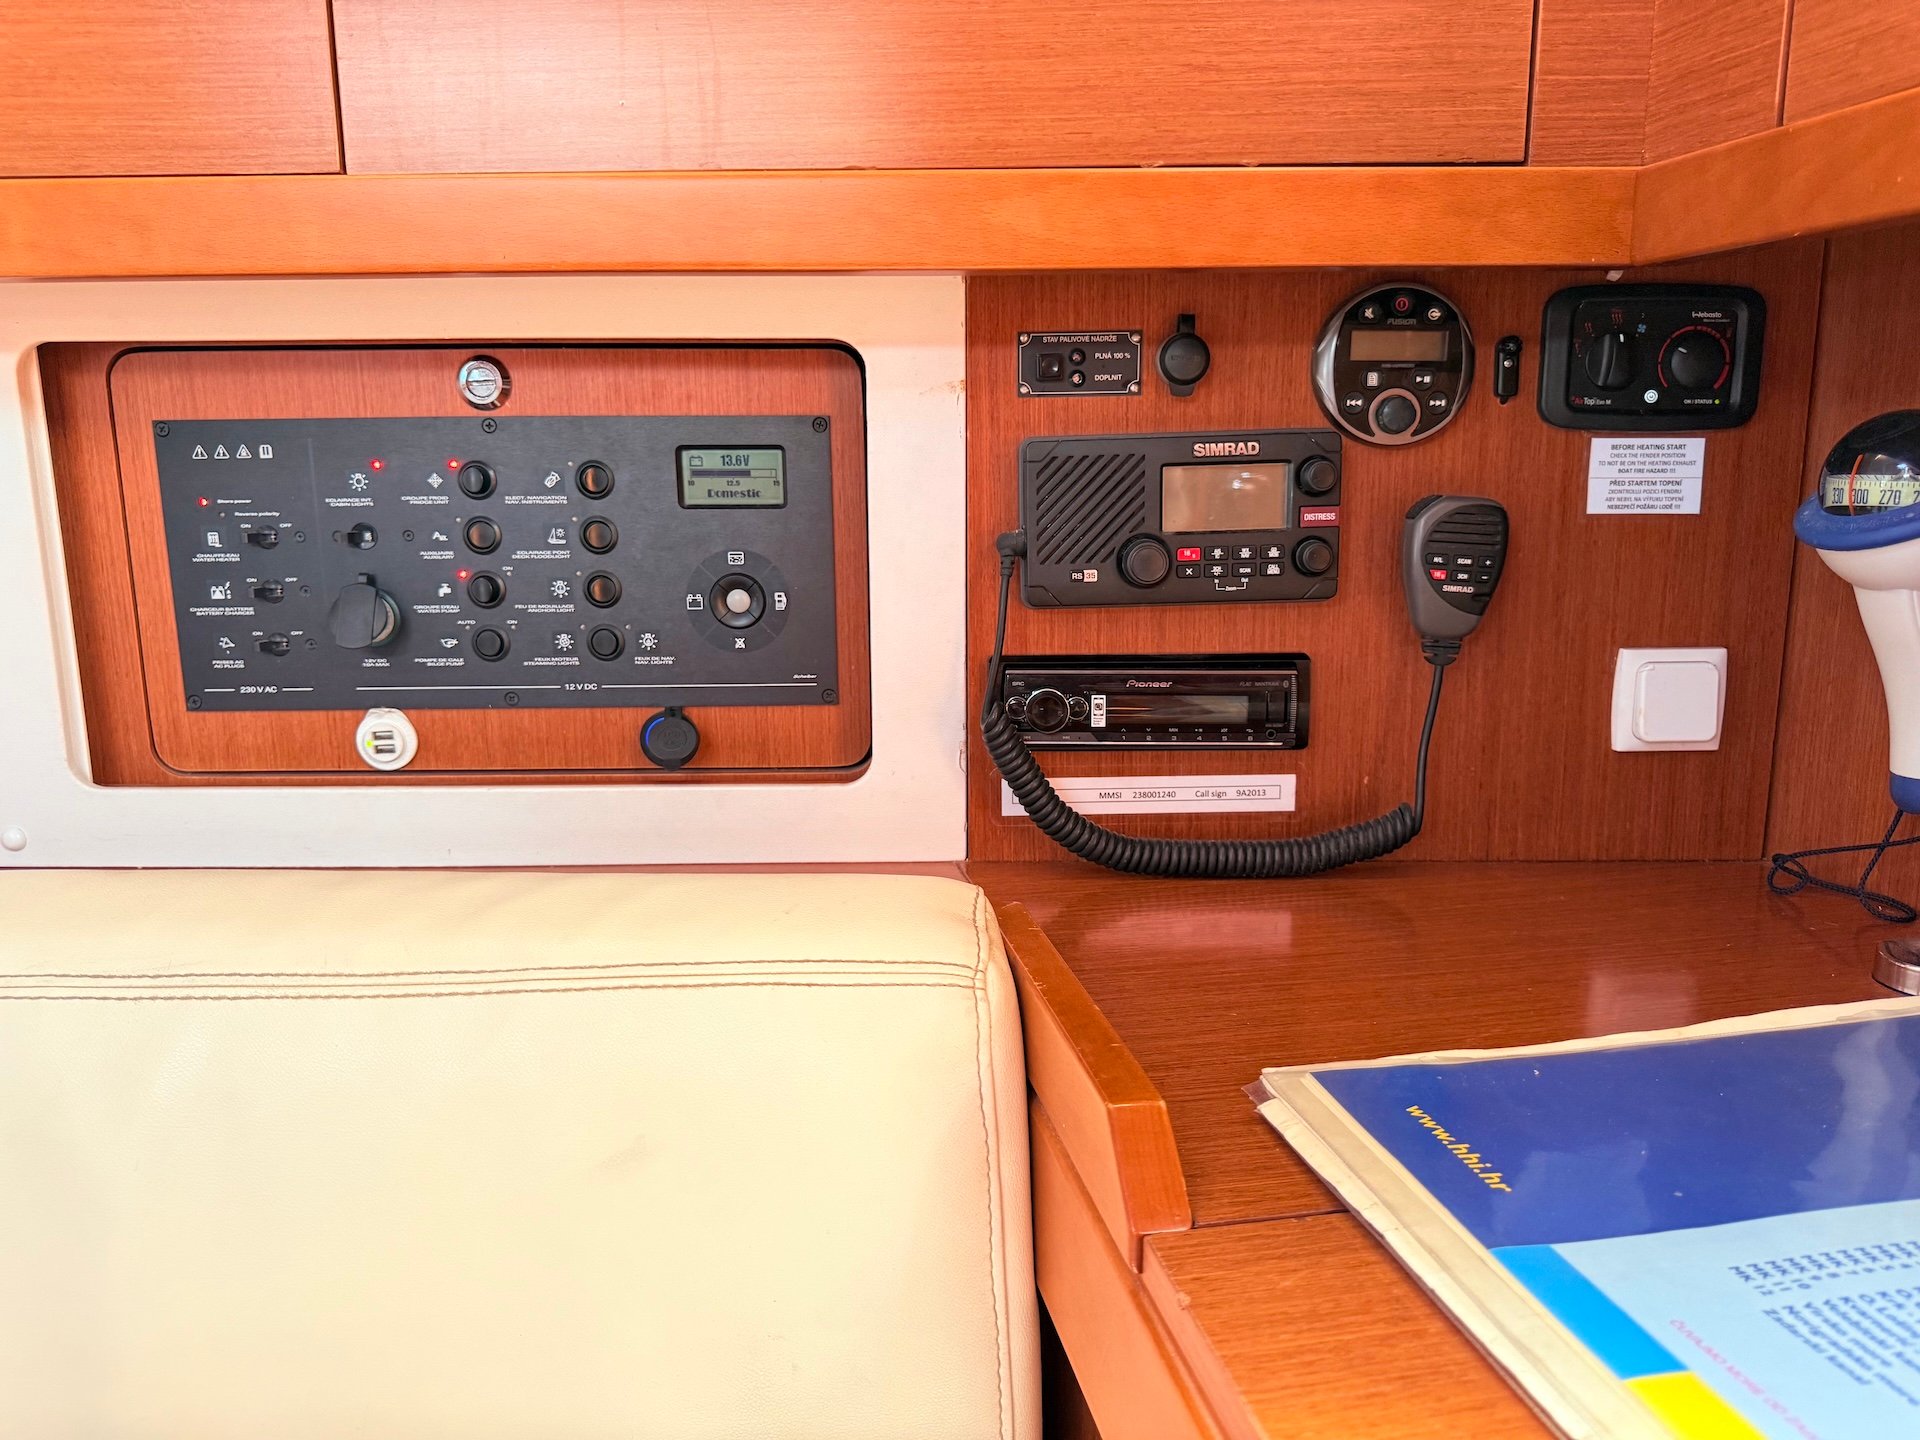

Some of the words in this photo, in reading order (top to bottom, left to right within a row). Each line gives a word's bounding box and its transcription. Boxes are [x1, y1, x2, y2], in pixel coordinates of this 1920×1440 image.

[1059, 335, 1090, 343] PALIVOVÉ
[1090, 334, 1117, 342] NÁDRŽE
[1094, 351, 1112, 360] PLNÁ
[1193, 441, 1260, 457] SIMRAD
[720, 454, 750, 467] 13.6V
[1609, 479, 1626, 487] PŘED
[1627, 479, 1657, 487] STARTEM
[1658, 479, 1683, 487] TOPENÍ
[707, 489, 762, 498] Domestic
[1878, 489, 1902, 505] 270
[1303, 512, 1335, 521] DISTRESS
[1072, 571, 1083, 580] RS
[1085, 571, 1096, 580] 35
[1442, 584, 1474, 594] SIMRAD
[1126, 679, 1173, 688] Pioneer
[1099, 791, 1122, 799] MMSI
[1132, 791, 1176, 799] 238001240
[1194, 789, 1210, 798] Call
[1210, 789, 1227, 799] sign
[1236, 789, 1266, 797] 9A2013
[1405, 1104, 1512, 1192] www.hhi.hr
[1790, 1278, 1812, 1290] 10
